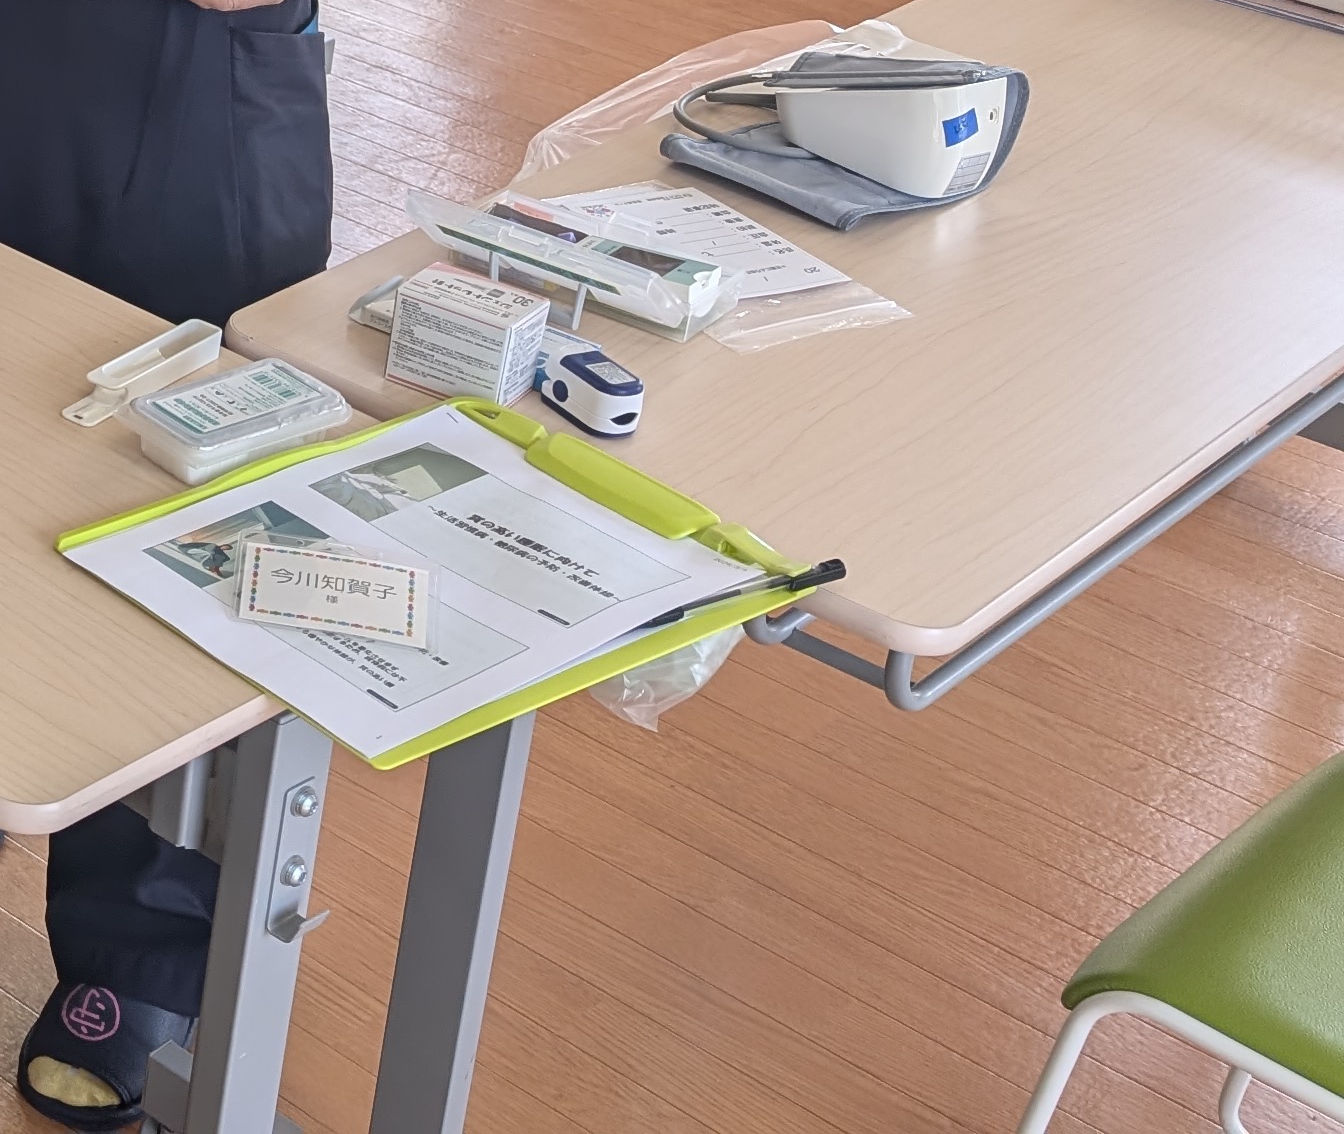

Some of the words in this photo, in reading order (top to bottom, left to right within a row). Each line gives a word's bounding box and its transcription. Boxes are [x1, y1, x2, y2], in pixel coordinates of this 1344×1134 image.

[467, 514, 600, 578] 質の高い睡眠に向けて
[271, 568, 397, 600] 今川知賀子
[326, 594, 339, 604] 様
